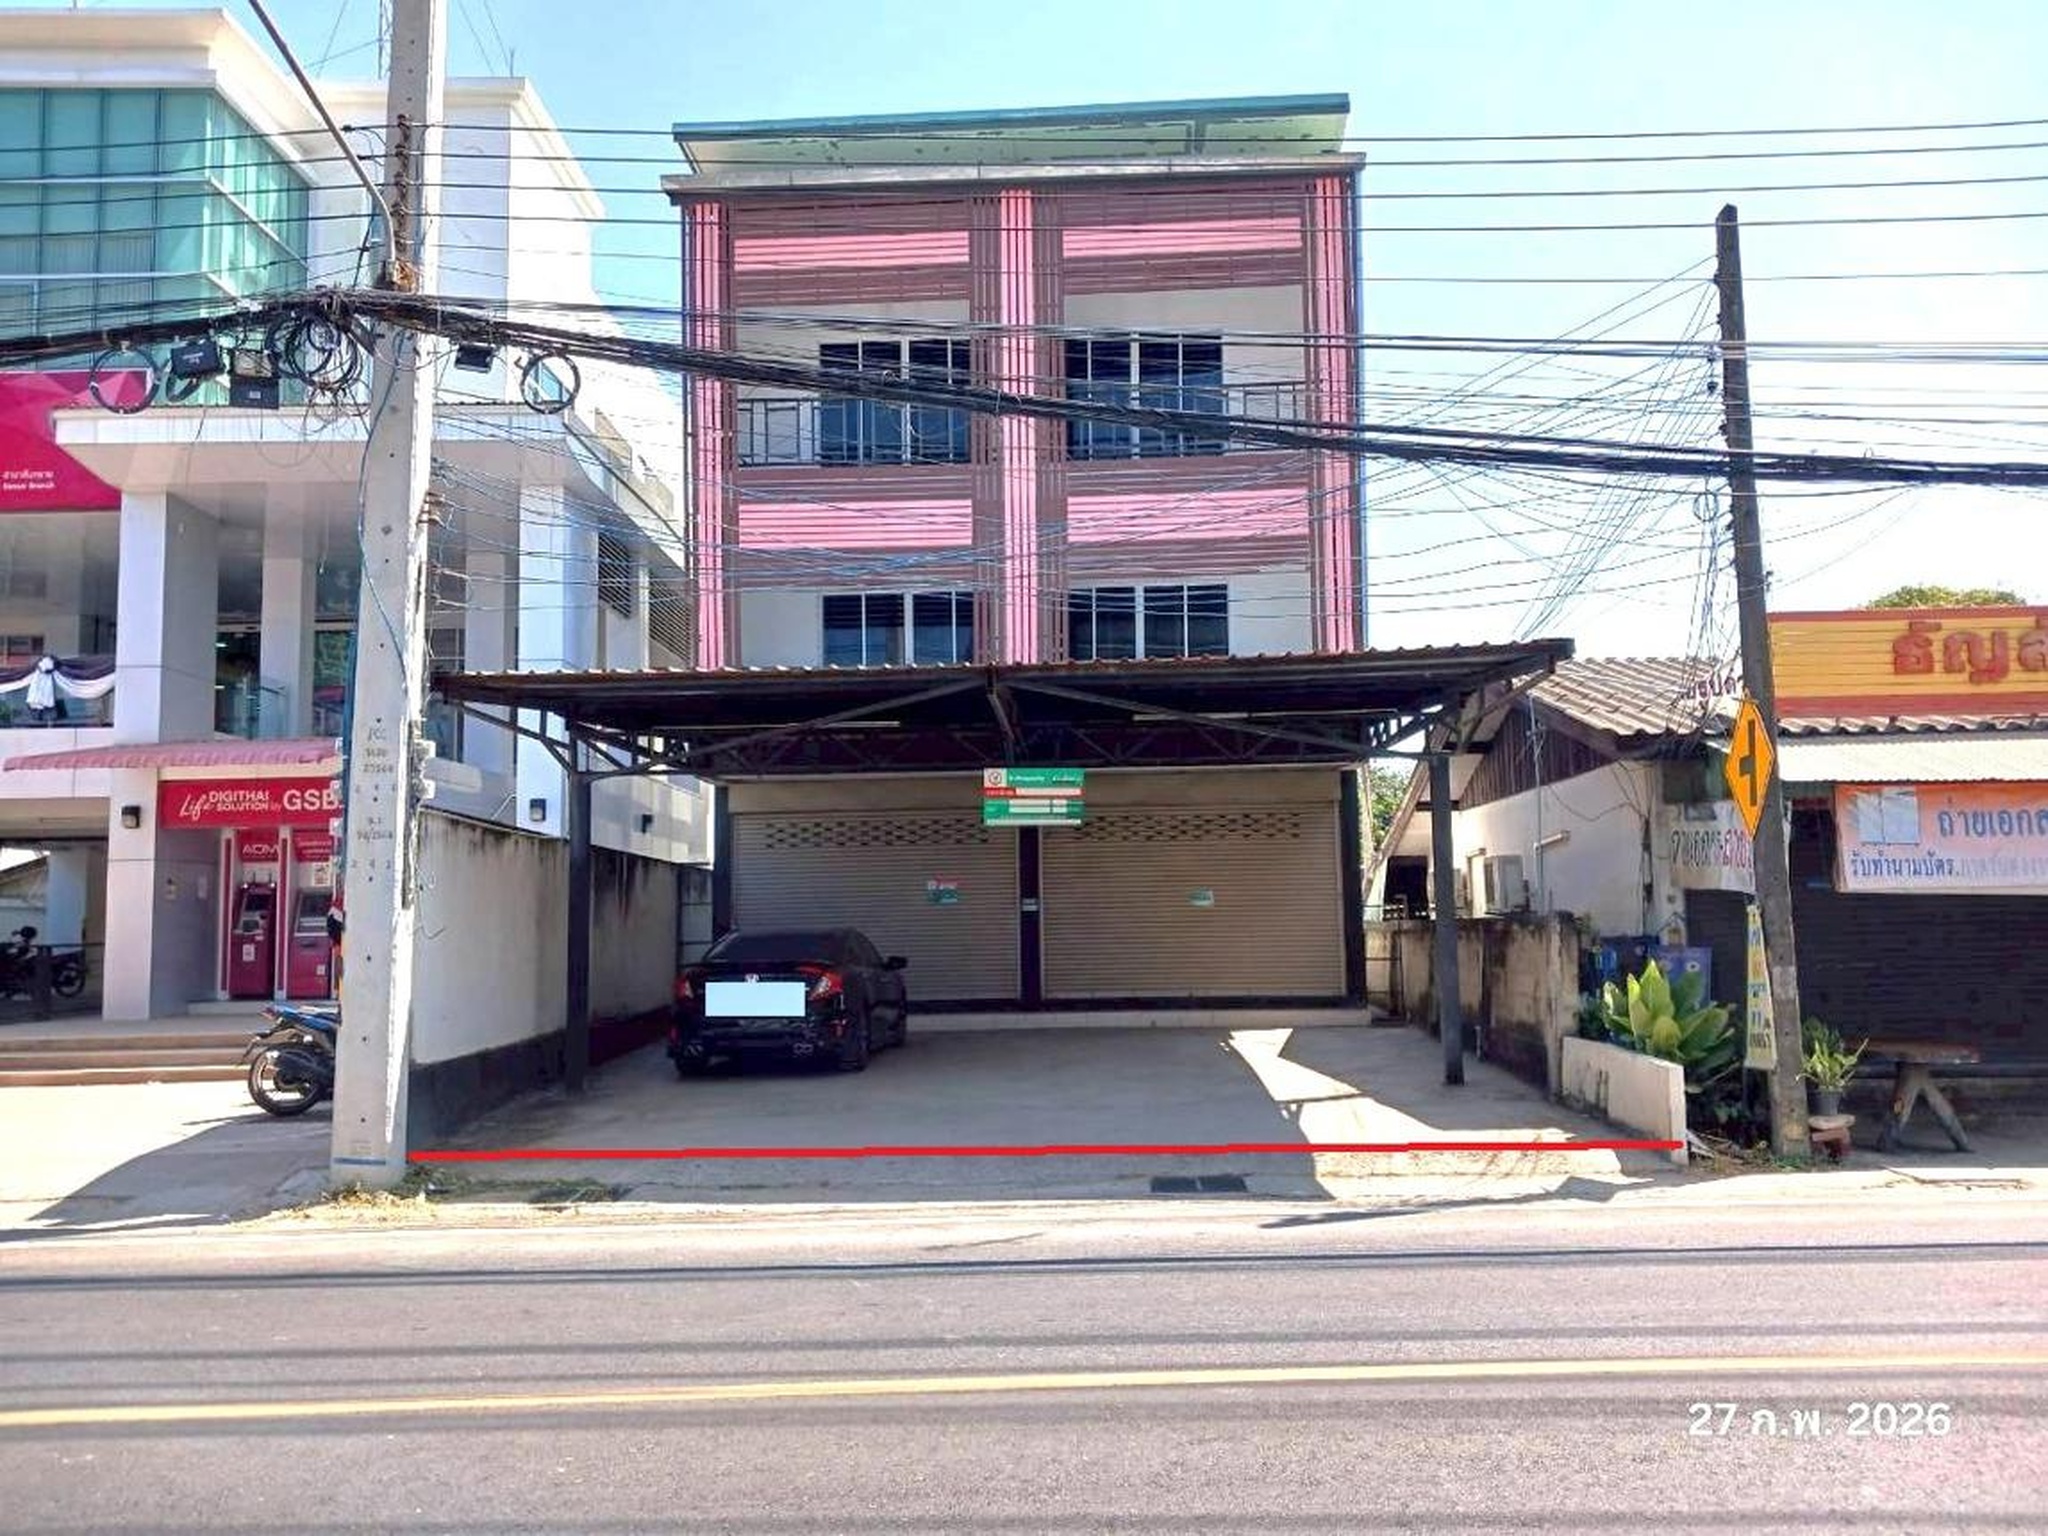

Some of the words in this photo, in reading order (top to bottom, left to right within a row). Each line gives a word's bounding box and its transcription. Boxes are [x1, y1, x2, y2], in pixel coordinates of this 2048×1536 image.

[208, 790, 270, 803] DIGITHAI
[283, 789, 338, 811] GSB
[178, 793, 214, 821] Life
[216, 802, 269, 812] SOLUTION
